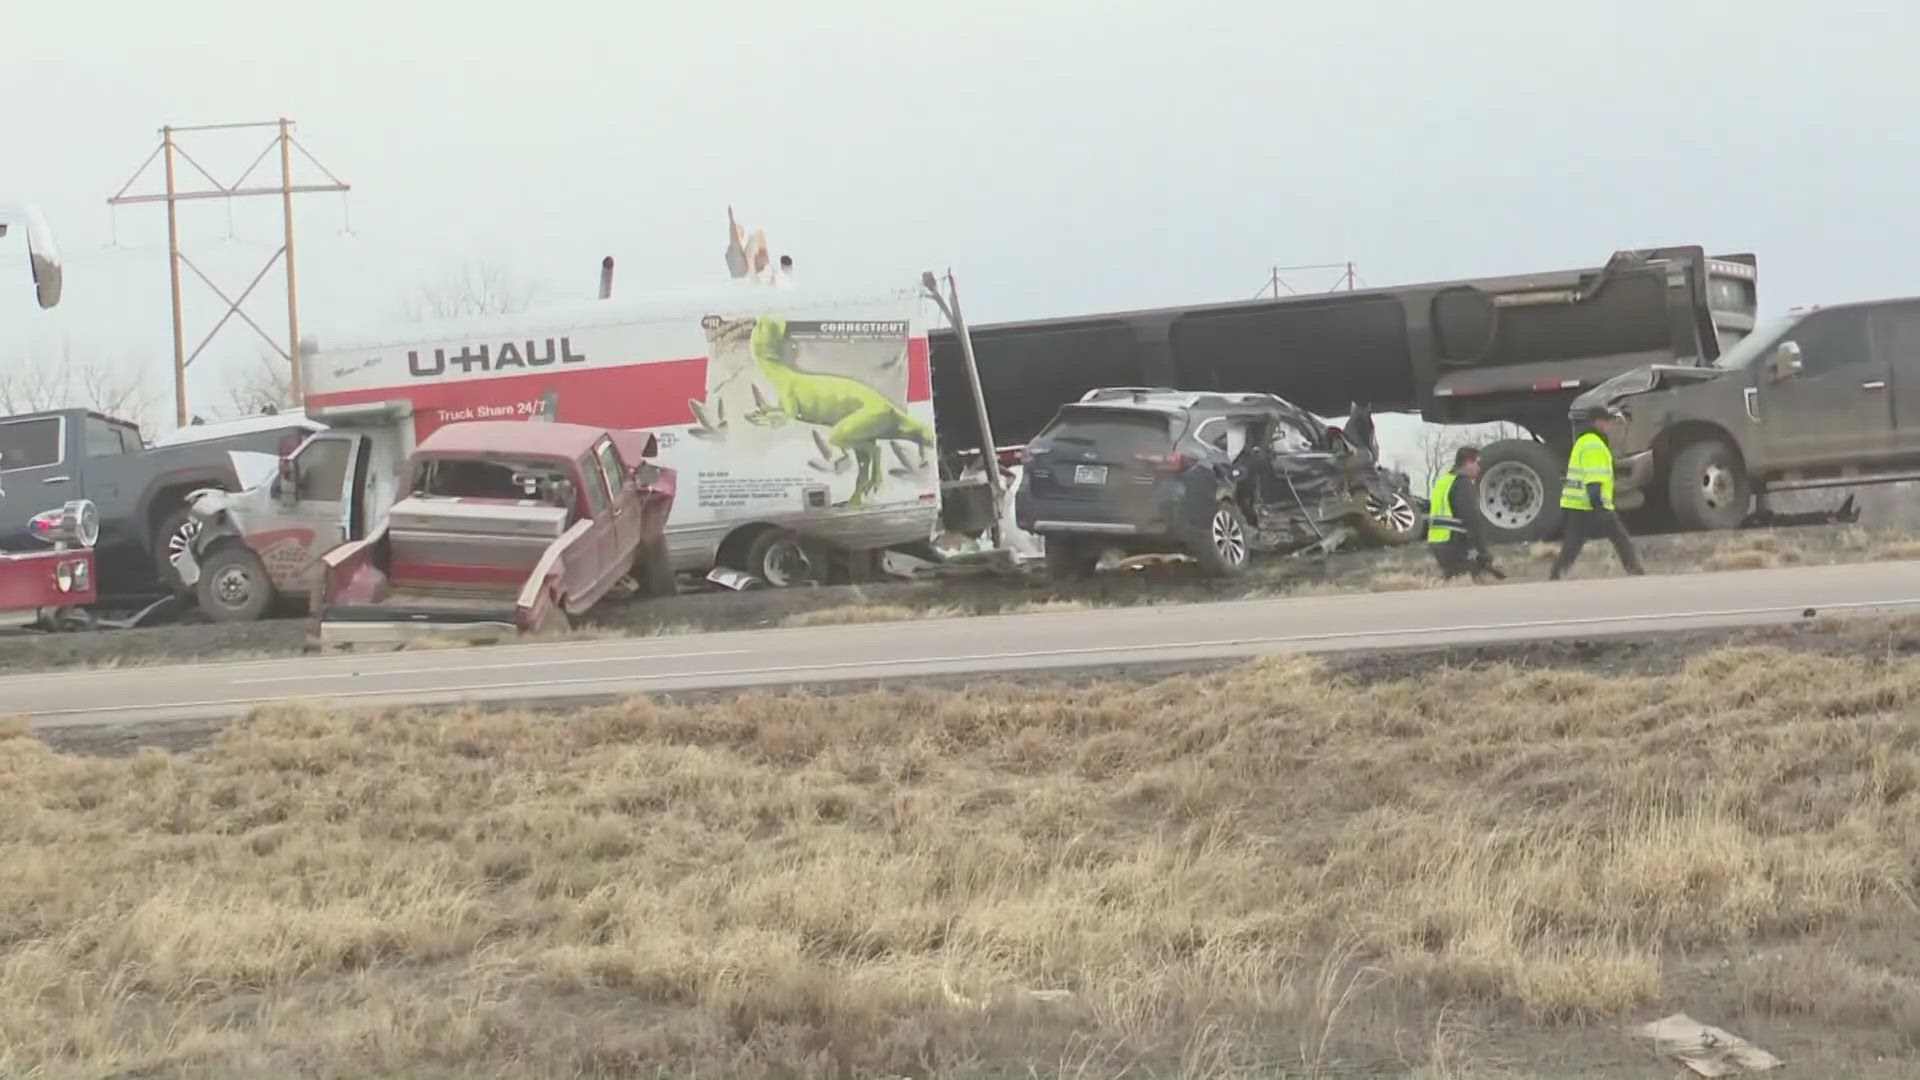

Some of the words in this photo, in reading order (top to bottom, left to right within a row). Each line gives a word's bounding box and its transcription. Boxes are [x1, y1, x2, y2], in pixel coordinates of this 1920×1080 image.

[820, 322, 905, 332] CONNECTICUT
[438, 408, 474, 421] Truck
[477, 405, 514, 418] Share
[517, 400, 546, 414] 24/7
